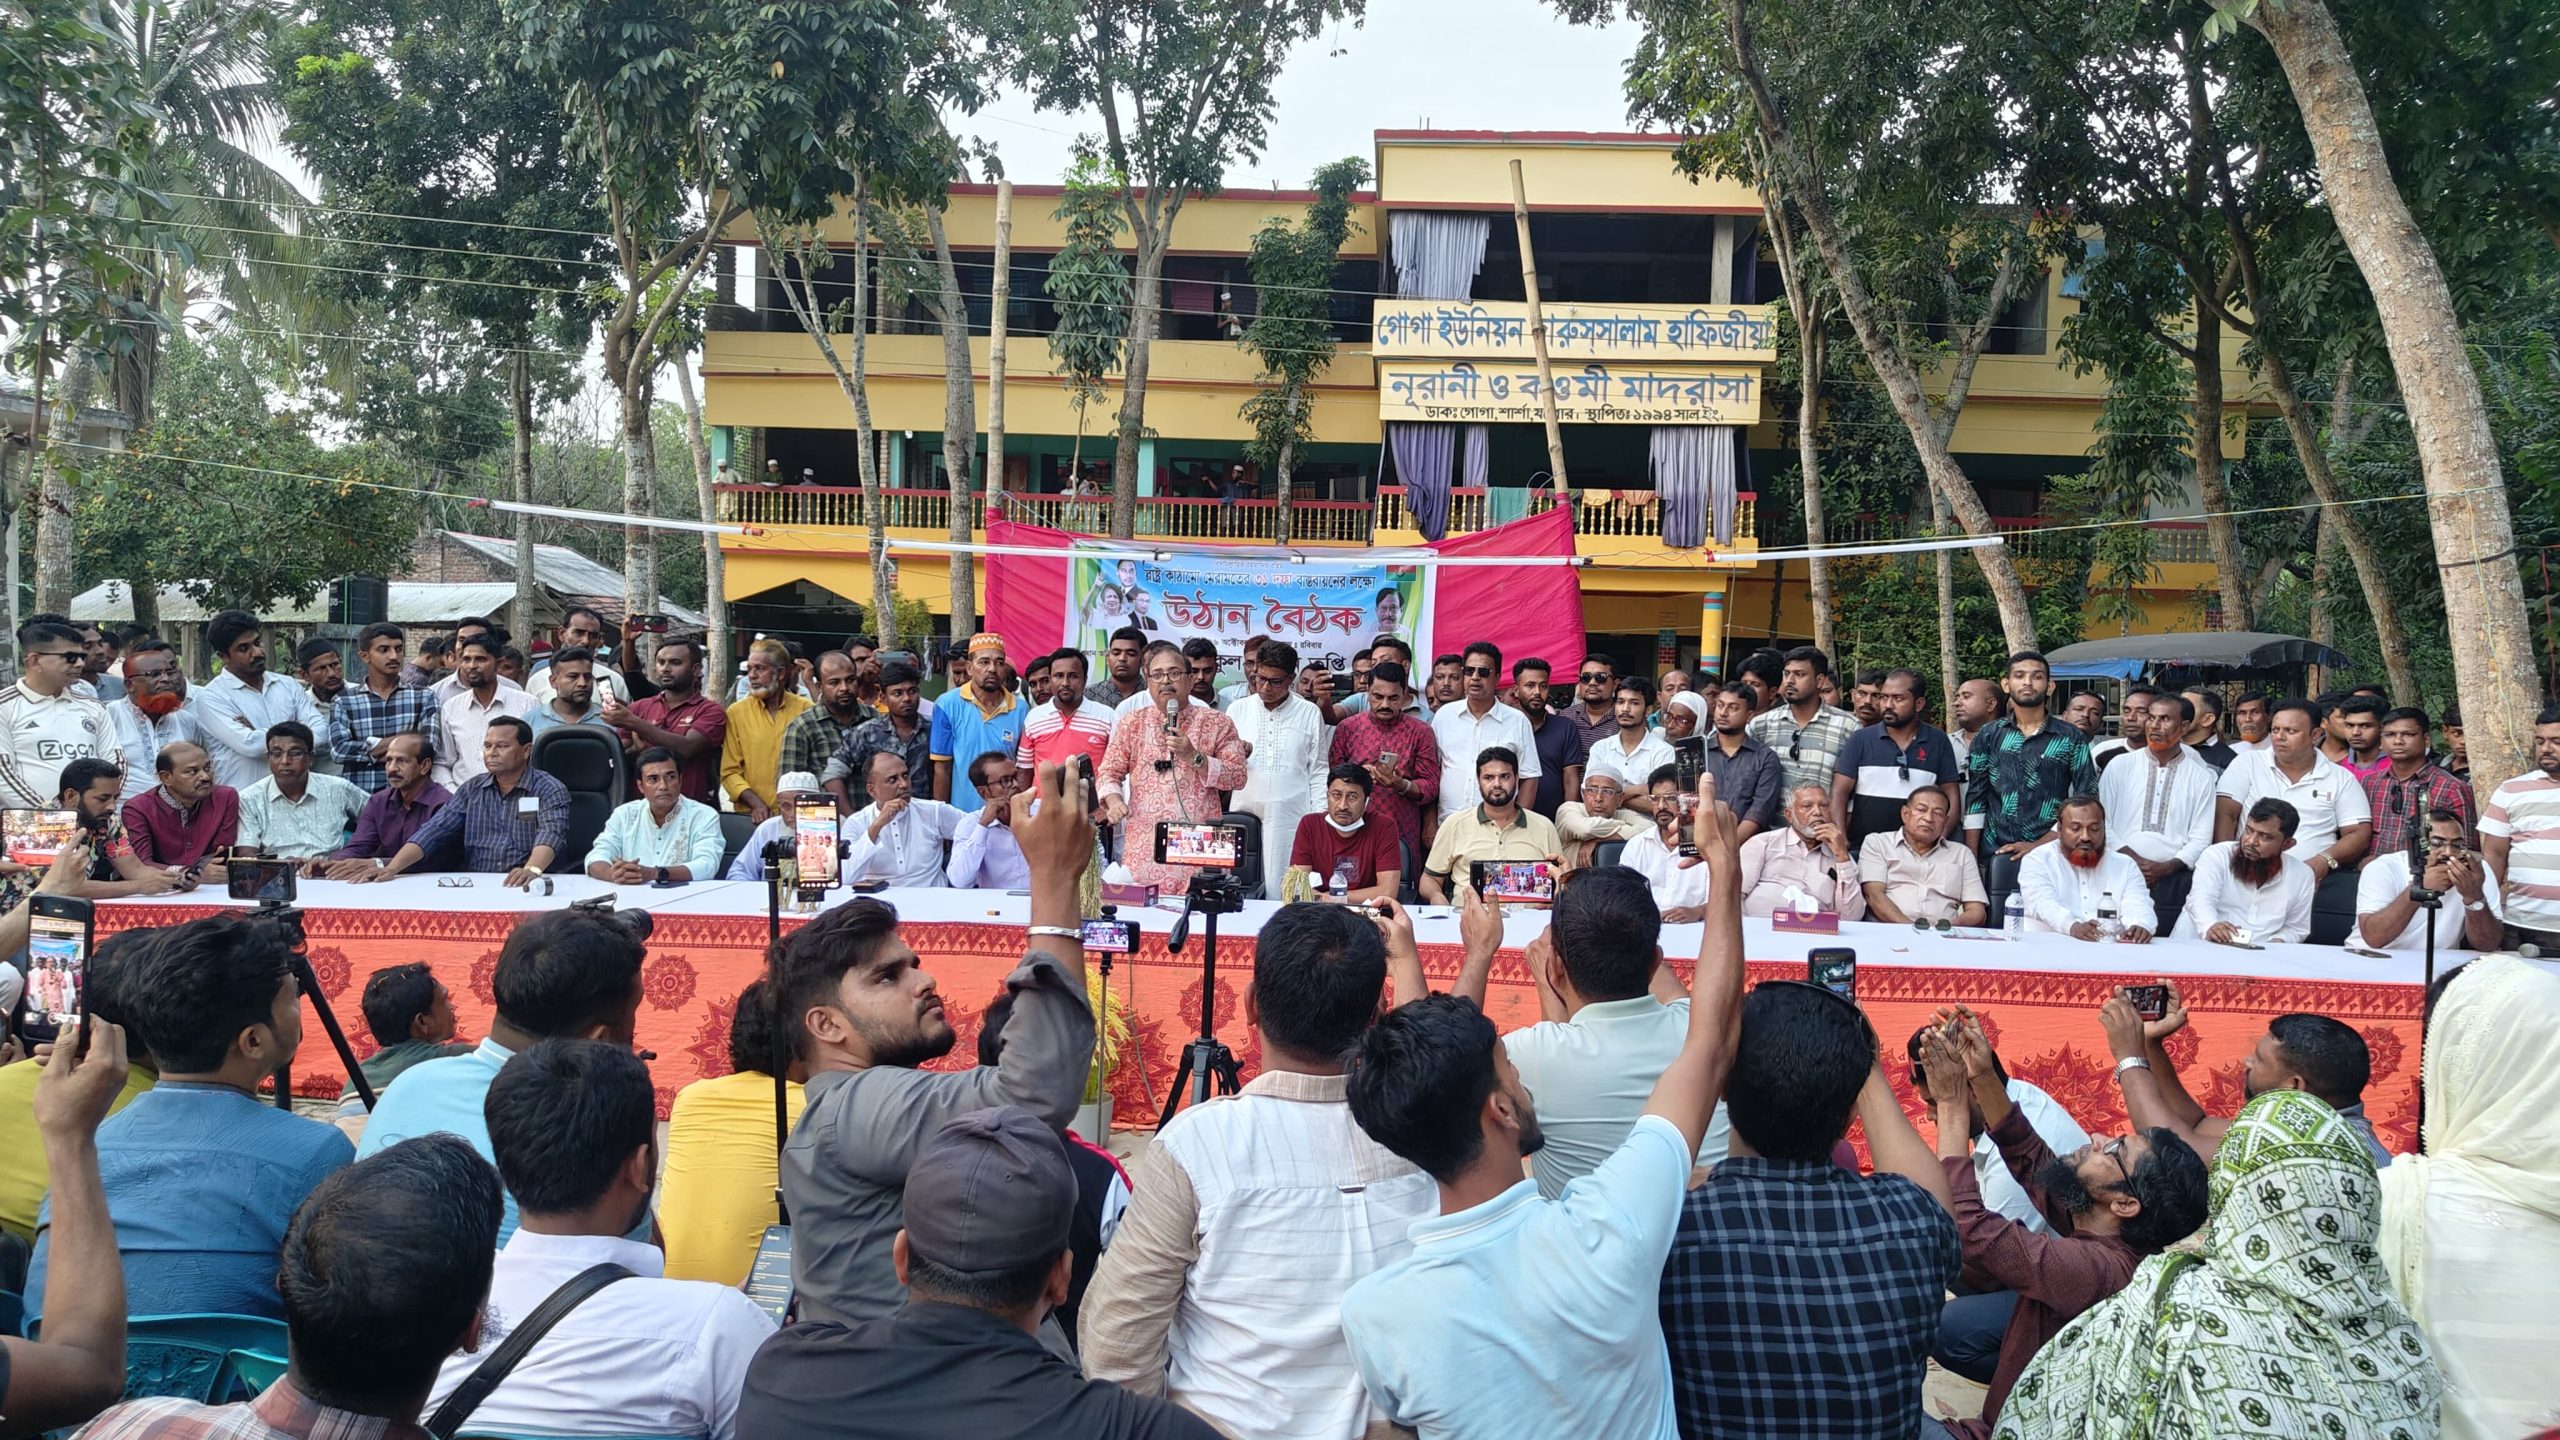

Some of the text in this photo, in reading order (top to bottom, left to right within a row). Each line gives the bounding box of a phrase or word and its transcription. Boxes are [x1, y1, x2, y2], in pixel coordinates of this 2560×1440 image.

[1377, 310, 1433, 346] গোগা
[1436, 305, 1526, 348] ইউনিয়ন
[1388, 361, 1482, 411] নূরানী
[1488, 375, 1510, 400] ও
[1618, 371, 1755, 406] মাদরাসা
[1633, 408, 1673, 421] ১৯৯৪
[1674, 408, 1700, 421] সাল
[1165, 566, 1201, 584] কাঠামো
[1255, 573, 1269, 587] ৩১
[1272, 573, 1293, 588] দফা
[1160, 588, 1368, 637] উঠান বৈঠক
